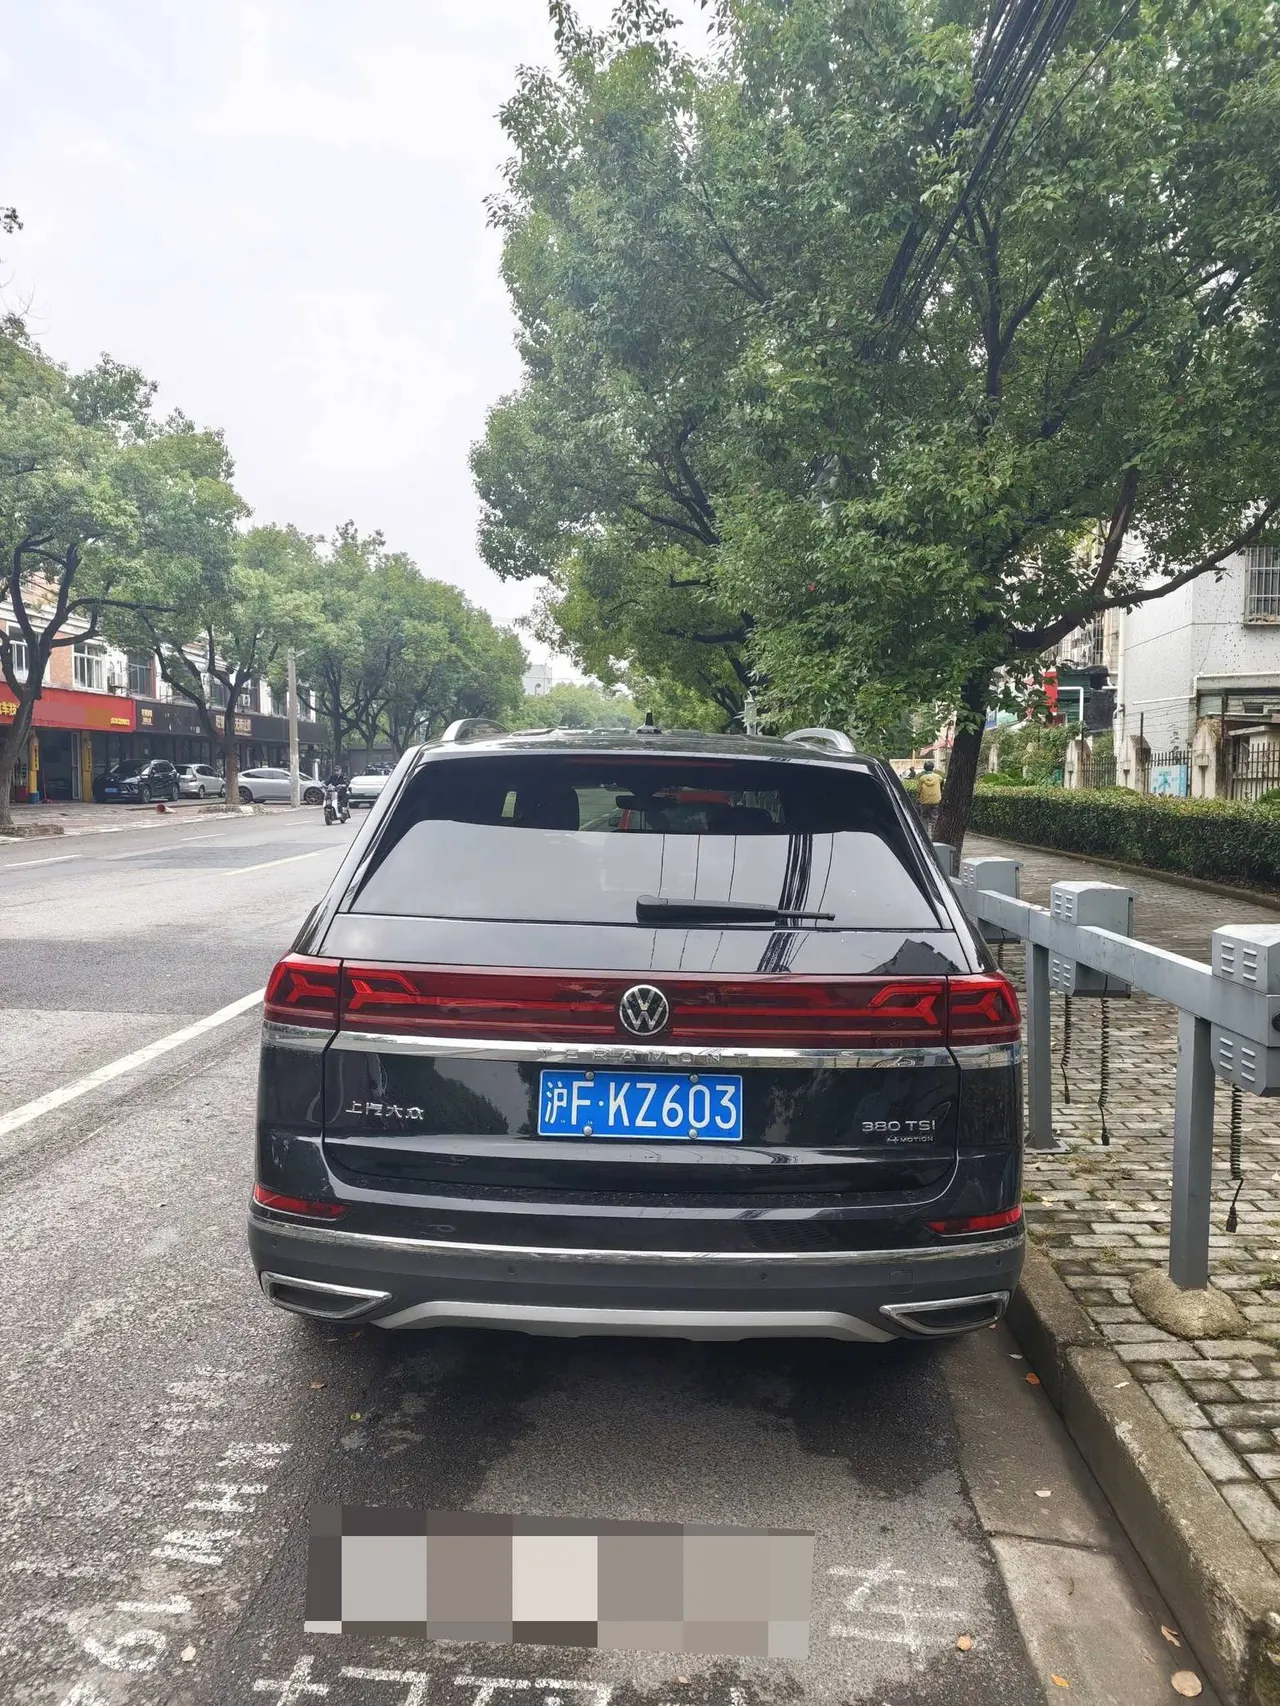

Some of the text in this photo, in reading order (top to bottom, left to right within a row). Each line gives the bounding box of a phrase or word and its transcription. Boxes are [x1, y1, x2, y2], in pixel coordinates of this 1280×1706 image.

[537, 1048, 749, 1065] TERAMONT
[345, 1100, 424, 1120] 上汽大众
[545, 1081, 737, 1130] 沪F·KZ603
[862, 1120, 935, 1132] 380 TSI
[886, 1133, 934, 1143] 4MOTION
